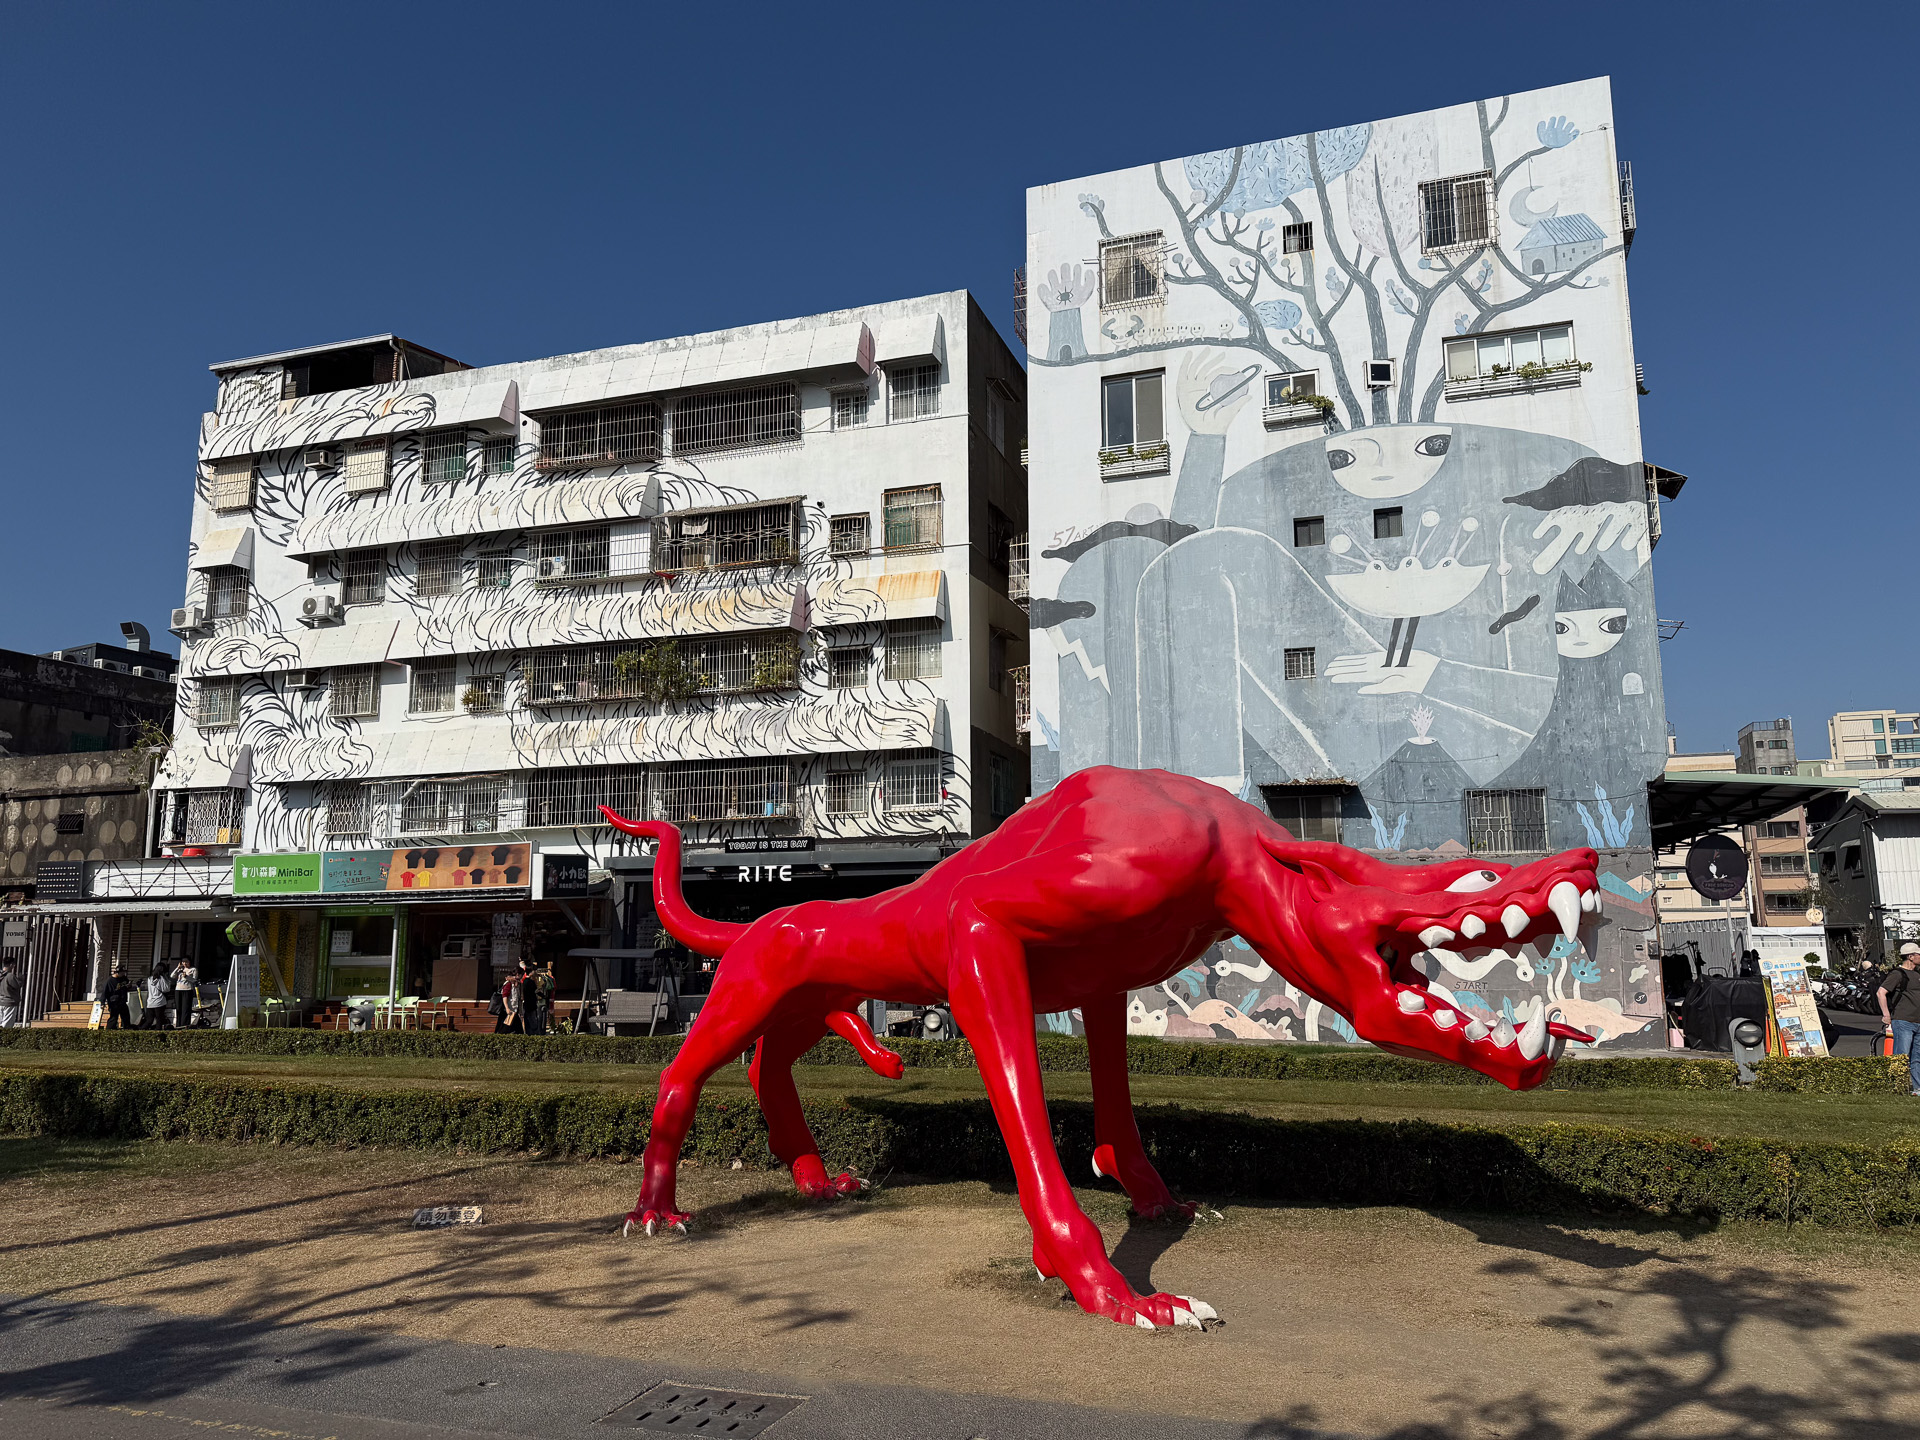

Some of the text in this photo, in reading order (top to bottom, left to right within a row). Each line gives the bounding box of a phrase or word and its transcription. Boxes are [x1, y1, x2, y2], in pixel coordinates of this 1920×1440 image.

[728, 841, 757, 850] TODAY
[759, 841, 768, 849] IS
[770, 841, 789, 849] THE
[277, 868, 314, 877] MiniBar
[738, 864, 792, 883] RITE
